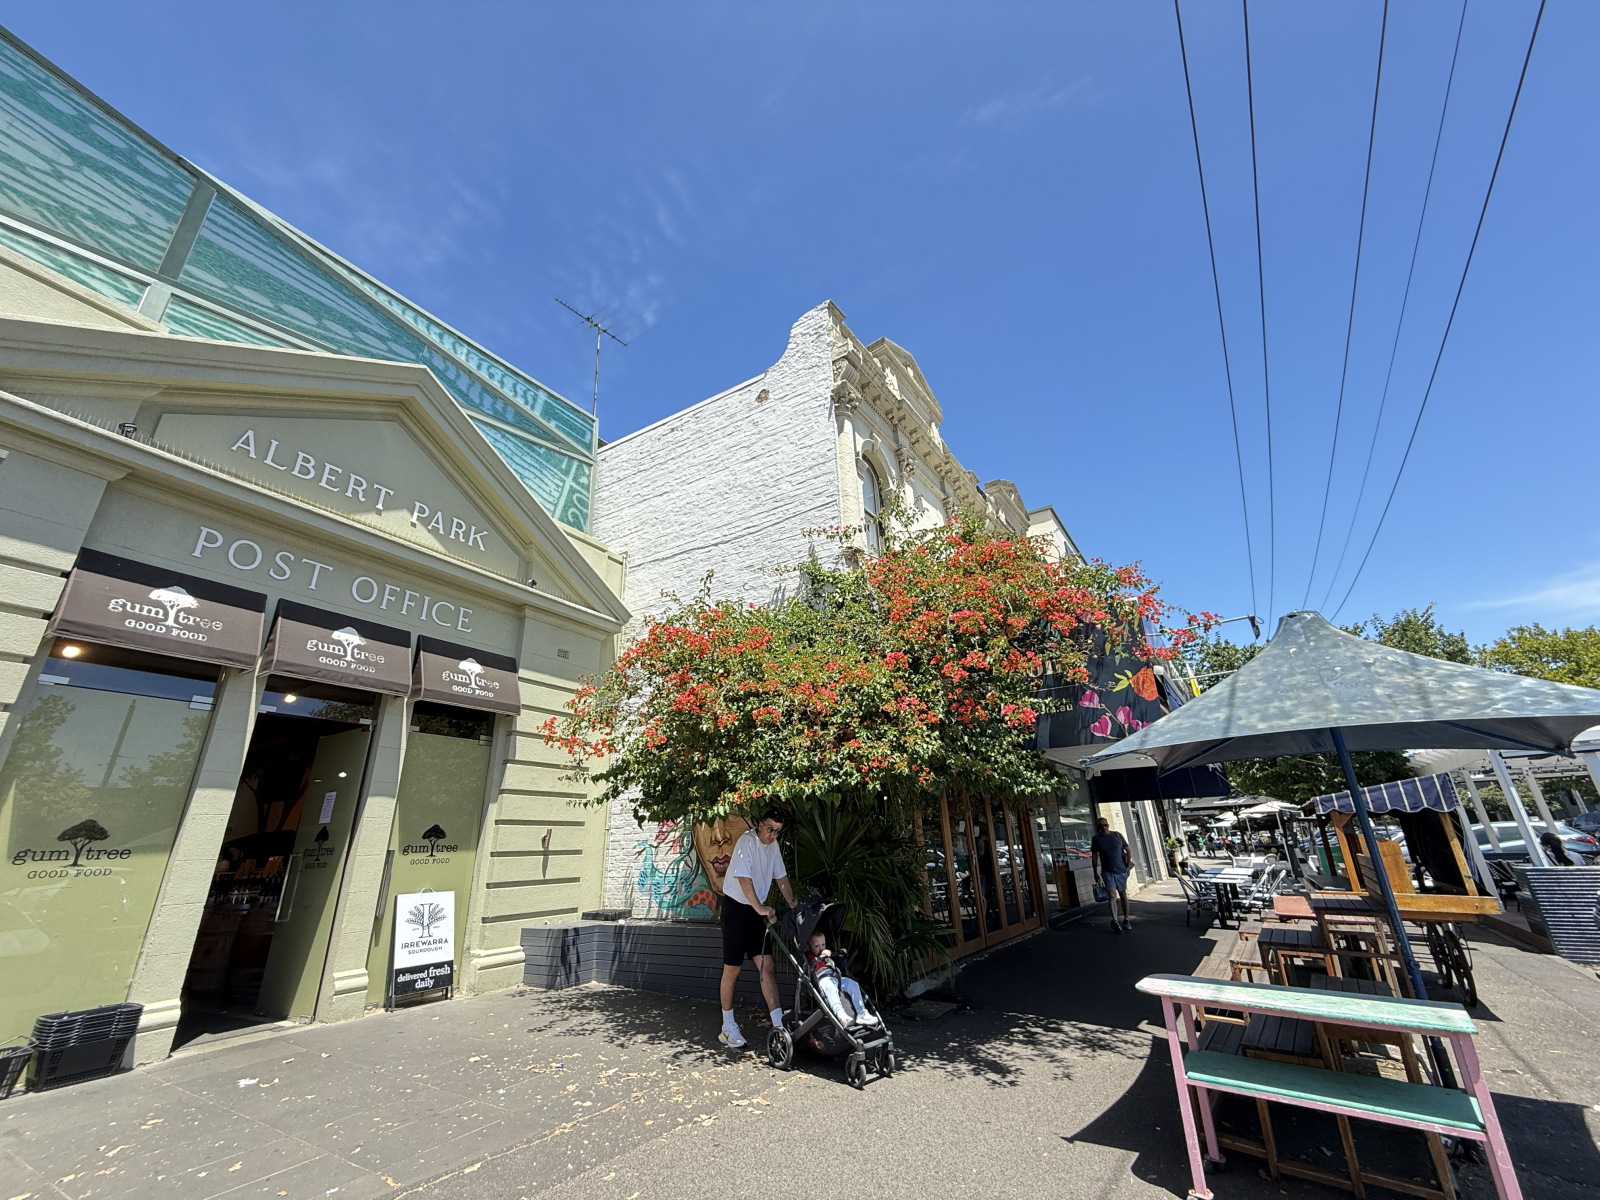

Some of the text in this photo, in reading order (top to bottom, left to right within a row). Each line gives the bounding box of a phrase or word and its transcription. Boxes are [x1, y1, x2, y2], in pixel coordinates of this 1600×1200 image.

[231, 429, 488, 551] ALBERT PARK
[191, 526, 473, 633] POST OFFICE
[107, 598, 223, 631] gum tree
[125, 619, 208, 642] GOOD FOOD
[306, 639, 385, 664] gum tree
[319, 656, 376, 673] GOOD FOOD
[442, 670, 500, 689] gum tree
[452, 685, 494, 698] GOOD FOOD
[11, 847, 132, 865] gum tree
[302, 846, 335, 859] gum tree
[402, 843, 458, 856] gum tree
[27, 868, 113, 879] GOOD FOOD
[401, 938, 449, 950] IRREWARRA
[407, 946, 443, 955] SOURDOUGH
[397, 964, 451, 982] delivered fresh
[415, 978, 435, 989] daily
